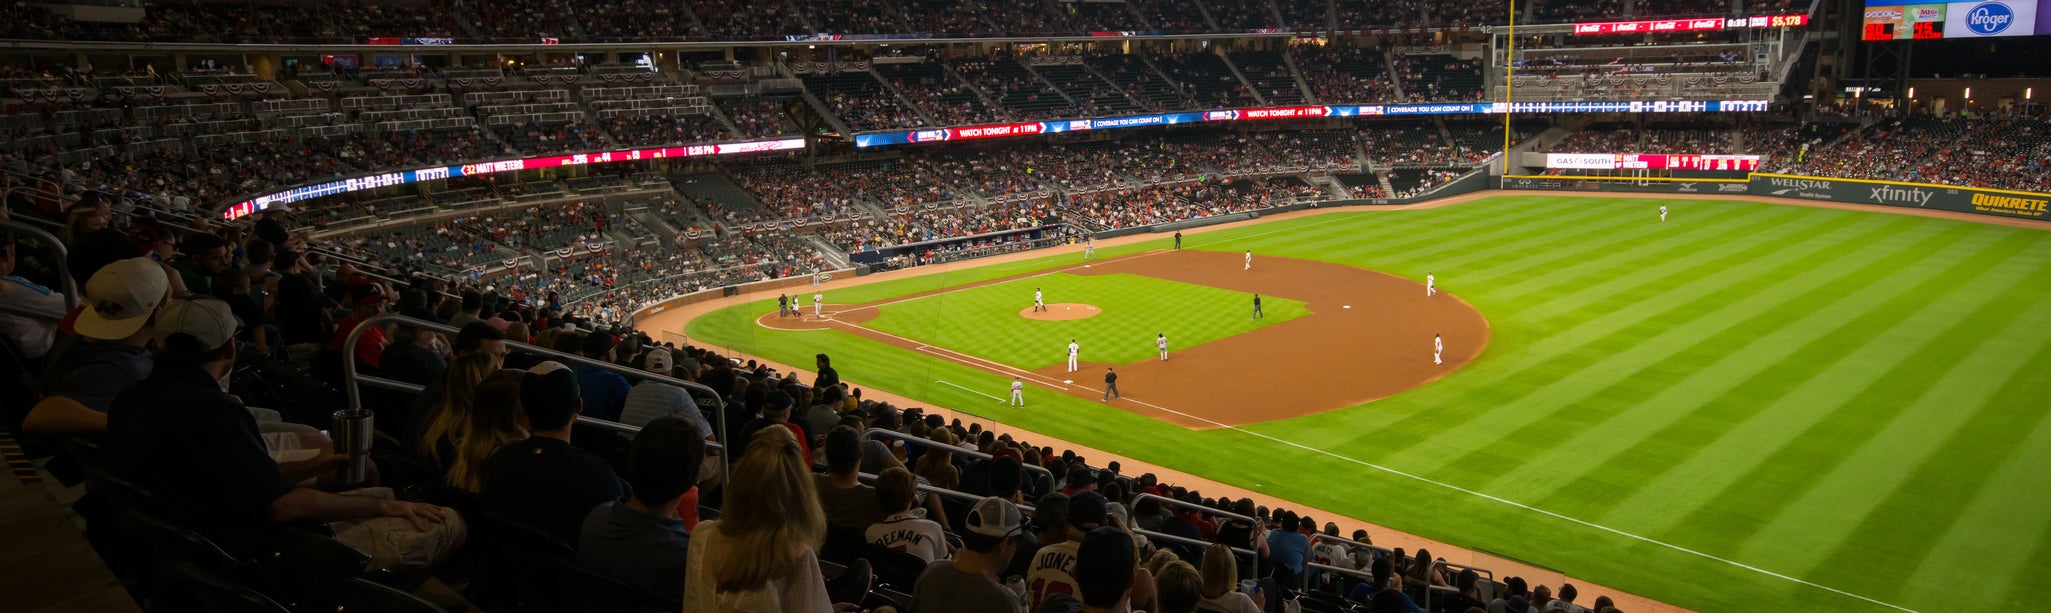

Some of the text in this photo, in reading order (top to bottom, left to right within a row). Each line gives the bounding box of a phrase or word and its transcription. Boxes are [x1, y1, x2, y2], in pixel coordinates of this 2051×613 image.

[1772, 16, 1801, 26] $5,178
[1971, 8, 2010, 31] Kroger
[1480, 25, 1492, 34] 42
[1097, 119, 1119, 127] COVERAGE
[1138, 117, 1152, 125] COUNT
[959, 128, 982, 137] WATCH
[983, 126, 1010, 136] TONIGHT
[1020, 124, 1037, 133] 11PM
[704, 145, 714, 154] PM
[1623, 154, 1639, 162] MATT
[466, 159, 524, 175] 32 MATT WIETERS
[1771, 177, 1831, 190] WELLSTAR
[1870, 184, 1933, 206] xfinity
[1971, 193, 2048, 212] QUIKRETE
[1036, 551, 1075, 575] JONE
